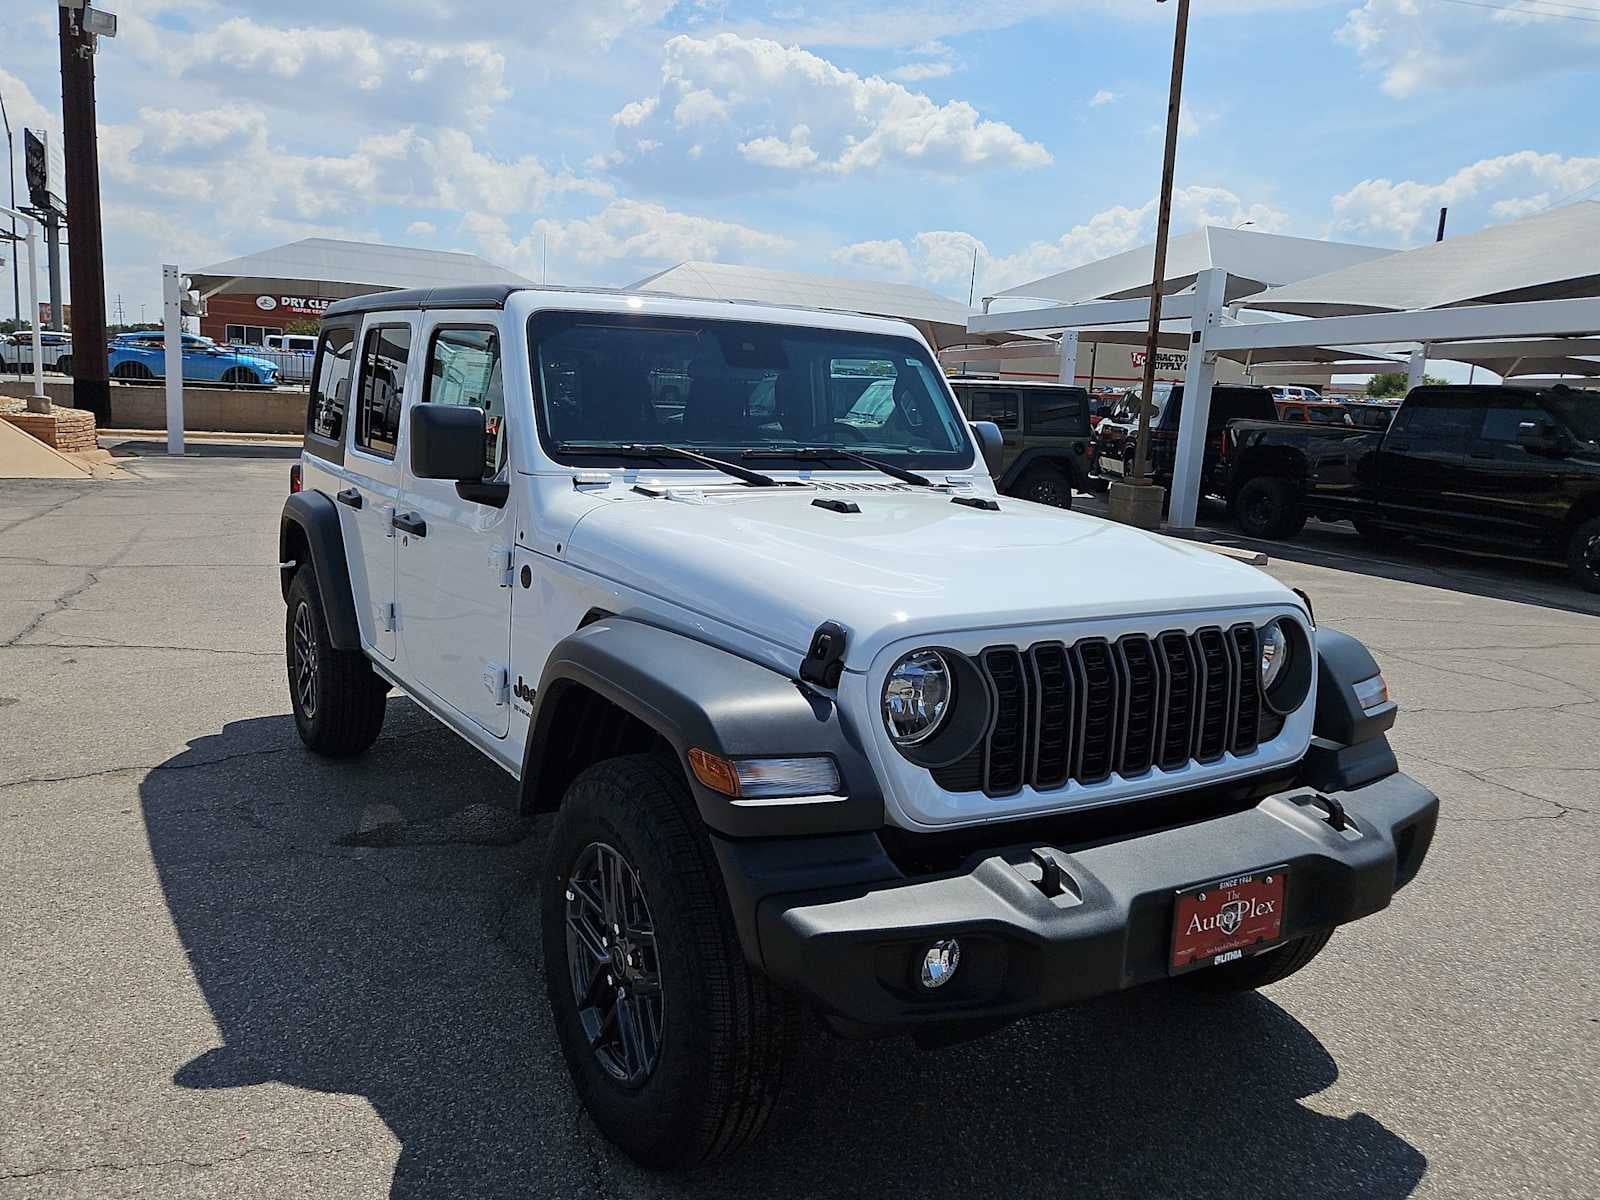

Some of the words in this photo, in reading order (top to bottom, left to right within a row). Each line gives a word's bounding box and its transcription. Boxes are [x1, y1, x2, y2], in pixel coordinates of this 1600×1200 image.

[281, 297, 306, 307] DRY
[308, 300, 329, 309] CLE
[1132, 353, 1146, 365] TSC
[1155, 353, 1188, 362] RACTO
[1154, 362, 1183, 370] UPPLY
[513, 675, 537, 706] Jee
[1219, 879, 1238, 889] SINCE
[1226, 890, 1241, 901] The
[1185, 897, 1276, 935] AutoPlex
